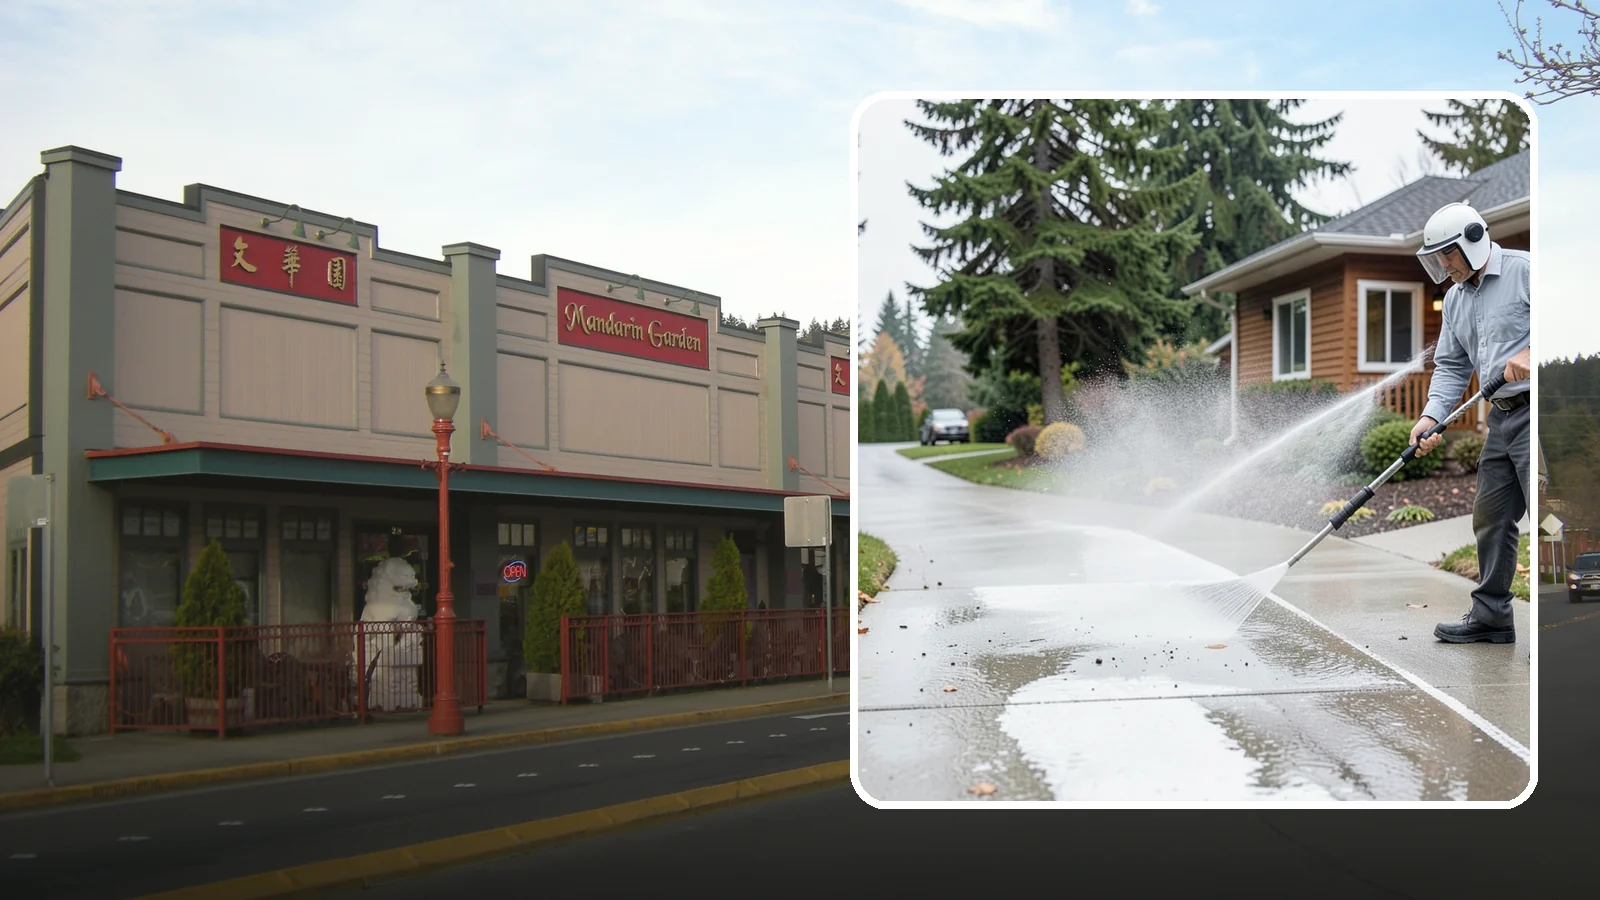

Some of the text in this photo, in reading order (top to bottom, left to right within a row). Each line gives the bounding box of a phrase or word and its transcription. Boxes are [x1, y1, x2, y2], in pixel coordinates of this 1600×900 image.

[230, 235, 347, 291] 文華園
[564, 302, 702, 352] Mandarin Garden
[503, 565, 527, 578] OPEN
